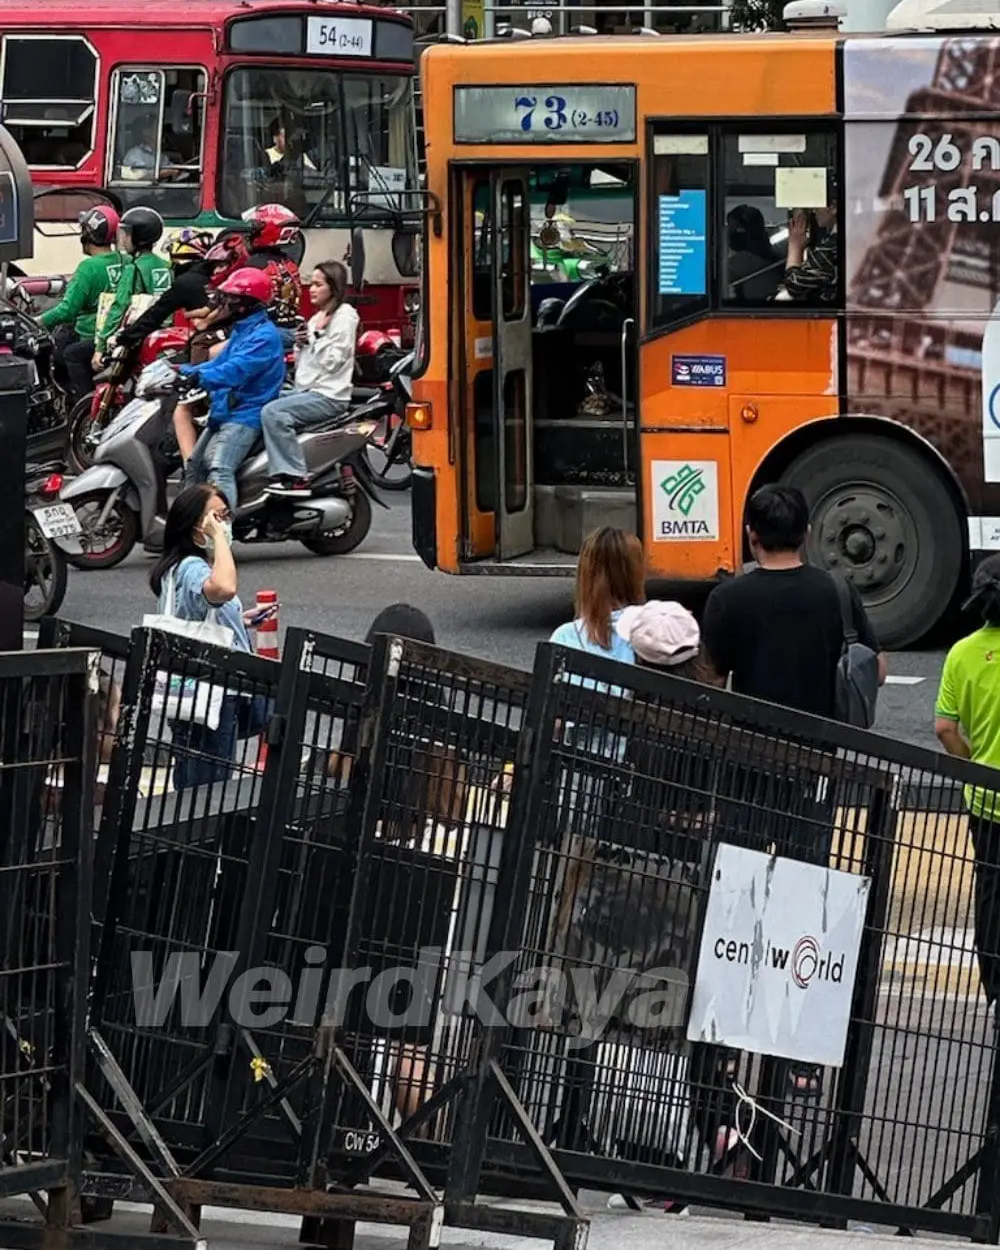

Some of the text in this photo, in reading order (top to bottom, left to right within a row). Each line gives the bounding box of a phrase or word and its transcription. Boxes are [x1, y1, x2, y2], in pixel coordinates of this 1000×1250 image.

[319, 25, 337, 46] 54
[514, 96, 620, 132] 73 (2-45)
[908, 134, 961, 172] 26
[904, 185, 936, 223] 11
[661, 520, 710, 535] BMTA
